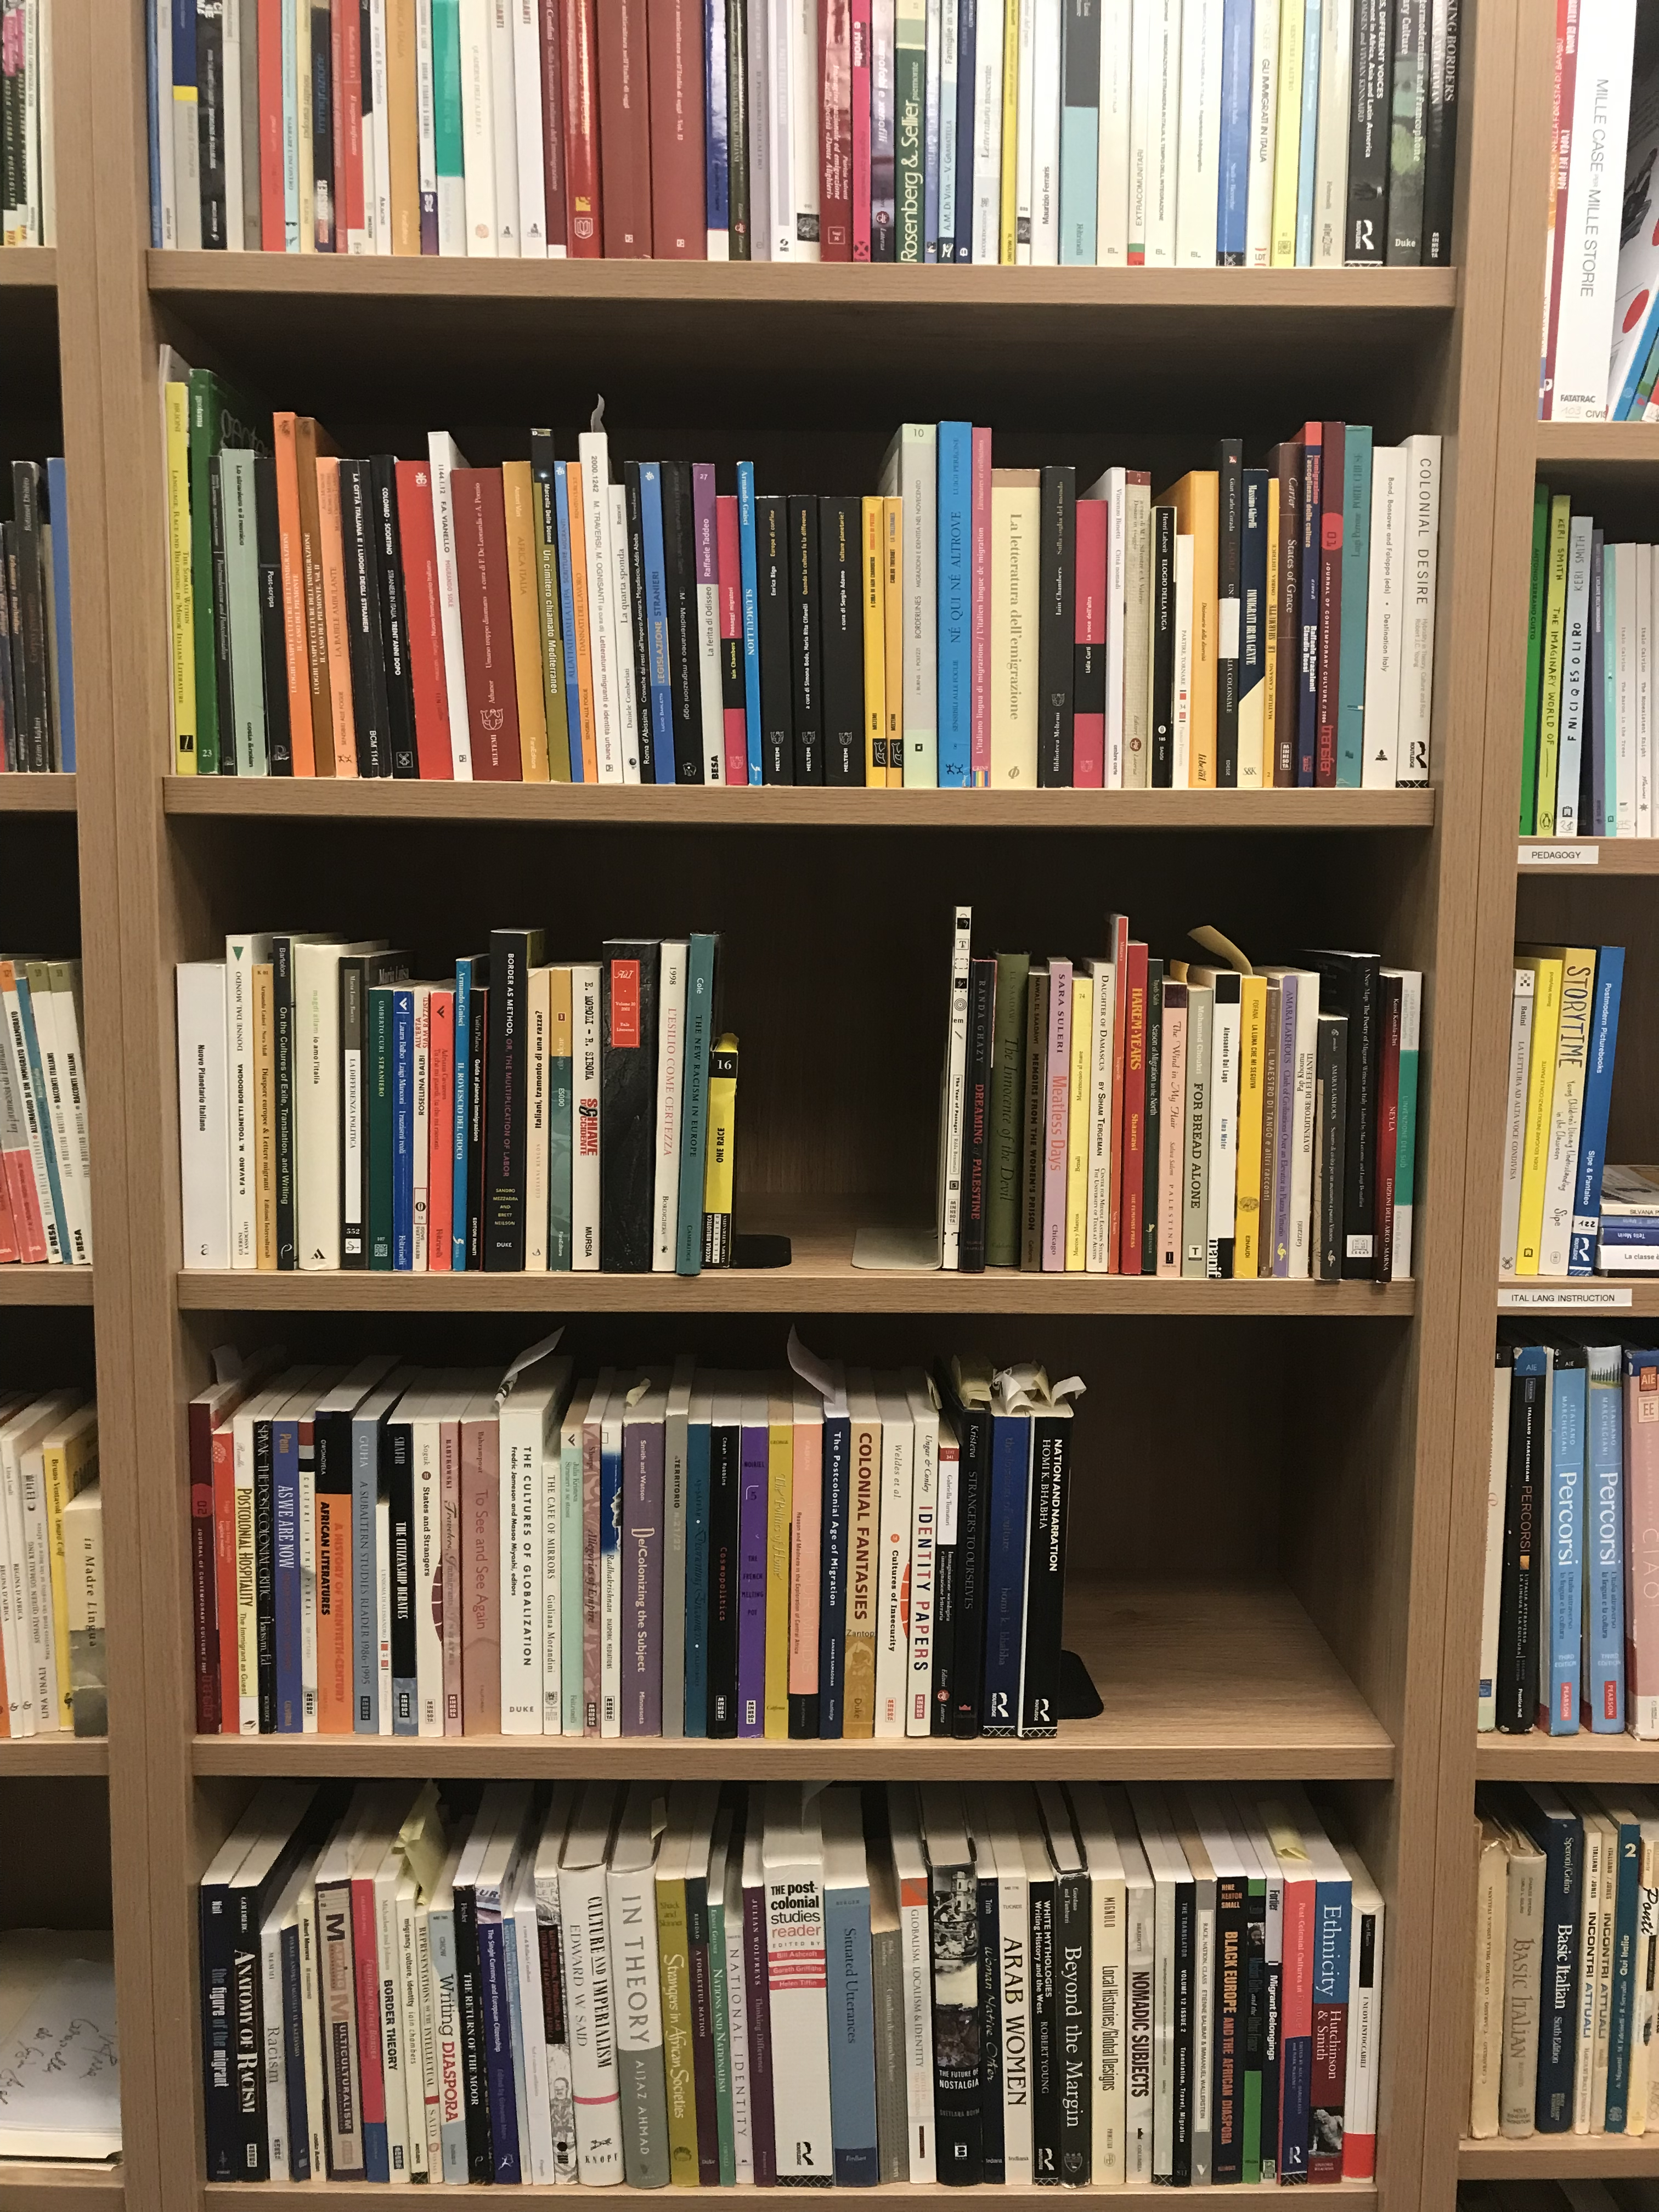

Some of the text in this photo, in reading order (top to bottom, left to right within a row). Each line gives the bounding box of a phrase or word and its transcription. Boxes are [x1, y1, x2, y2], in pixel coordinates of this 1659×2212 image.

[1376, 12, 1385, 98] DIFFERENT VOICES
[1444, 36, 1457, 101] BORDERS
[1260, 127, 1268, 135] IN
[1261, 77, 1269, 124] IMMIGRATI
[1593, 79, 1608, 125] MILLE
[900, 100, 923, 262] Rosenberg & Sellier
[1590, 129, 1605, 172] CASE
[1586, 189, 1602, 235] MILLE
[1581, 240, 1597, 297] STORIE
[1560, 394, 1596, 403] FATATRAC
[1009, 514, 1022, 532] La
[1415, 459, 1431, 605] COLONIAL DESIRE
[1556, 518, 1565, 580] KERI SMITH
[267, 571, 276, 607] Post-scripta
[949, 512, 962, 643] NÉ QUI NÉ ALTROVE
[1008, 535, 1023, 605] letteratura
[1284, 539, 1296, 613] States of Grace
[543, 550, 558, 693] Un cimitero chiamato Mediterraneo
[744, 589, 754, 655] SLUMGULLION
[1546, 607, 1560, 746] THE IMAGINARY WORLD OF
[709, 755, 719, 779] BESA
[505, 953, 515, 1036] BORDER AS METHOD,
[669, 966, 677, 985] 1998
[1056, 974, 1065, 1054] SARA SULERI
[1558, 966, 1590, 1068] STORYTIME
[1596, 983, 1611, 1073] Postmodern Picturebooks
[349, 1059, 356, 1067] LA
[692, 1064, 700, 1102] RACISM
[690, 1120, 698, 1158] EUROPE
[691, 1105, 699, 1117] IN
[715, 1128, 725, 1163] ONE RACE
[1049, 1076, 1066, 1171] Meatless Days
[1130, 1113, 1138, 1150] Shaarawi
[1190, 1083, 1203, 1209] FOR BREAD ALONE
[1387, 1106, 1396, 1131] NEYLA
[422, 1487, 431, 1513] States
[831, 1455, 840, 1516] Postcolonial
[1039, 1439, 1051, 1529] HOMI K. BHABHA
[1049, 1439, 1062, 1571] NATION AND NARRATION
[1520, 1486, 1532, 1552] PERCORSI
[1558, 1472, 1578, 1566] Percorsi
[1599, 1472, 1620, 1565] Percorsi
[236, 1488, 253, 1606] POSTCOLONIAL HOSPITALITY
[320, 1502, 330, 1615] AFRICAN LITERATURES
[422, 1534, 431, 1576] Strangers
[473, 1490, 488, 1629] To See and See Again
[523, 1543, 531, 1558] OF
[830, 1521, 838, 1540] Age
[831, 1545, 838, 1554] of
[855, 1433, 872, 1620] COLONIAL FANTASIES
[83, 1538, 98, 1647] in Madre Lingua
[396, 1521, 408, 1618] THE CITIZENSHIP DEBATES
[828, 1559, 838, 1606] Migration
[913, 1506, 933, 1671] IDENTITY PAPERS
[523, 1565, 531, 1666] GLOBALIZATION
[1606, 1685, 1614, 1715] PEARSON
[770, 1881, 819, 1896] THE post-
[770, 1895, 820, 1910] colonial
[771, 1910, 821, 1925] studies
[771, 1925, 822, 1938] reader
[1316, 1905, 1341, 1996] Ethnicity
[1555, 1924, 1572, 2009] Basic Italian
[588, 1897, 612, 2068] CULTURE AND IMPERIALISM
[623, 1895, 649, 2044] IN THEORY
[844, 1928, 858, 2044] Situated Utterances
[1583, 1912, 1596, 2038] INCONTRI ATTUALI
[240, 2029, 253, 2049] OF
[384, 1980, 397, 2070] BORDER THEORY
[438, 1974, 458, 2122] Writing DIASPORA
[1004, 1937, 1026, 2106] ARAB WOMEN
[1062, 1946, 1084, 2127] Beyond the Margin
[1131, 1972, 1149, 2097] NOMADIC SUBJECTS
[1267, 1975, 1278, 2060] Migrant Belongings
[1316, 2011, 1329, 2061] & Smith
[1328, 2010, 1341, 2079] Hutchinson
